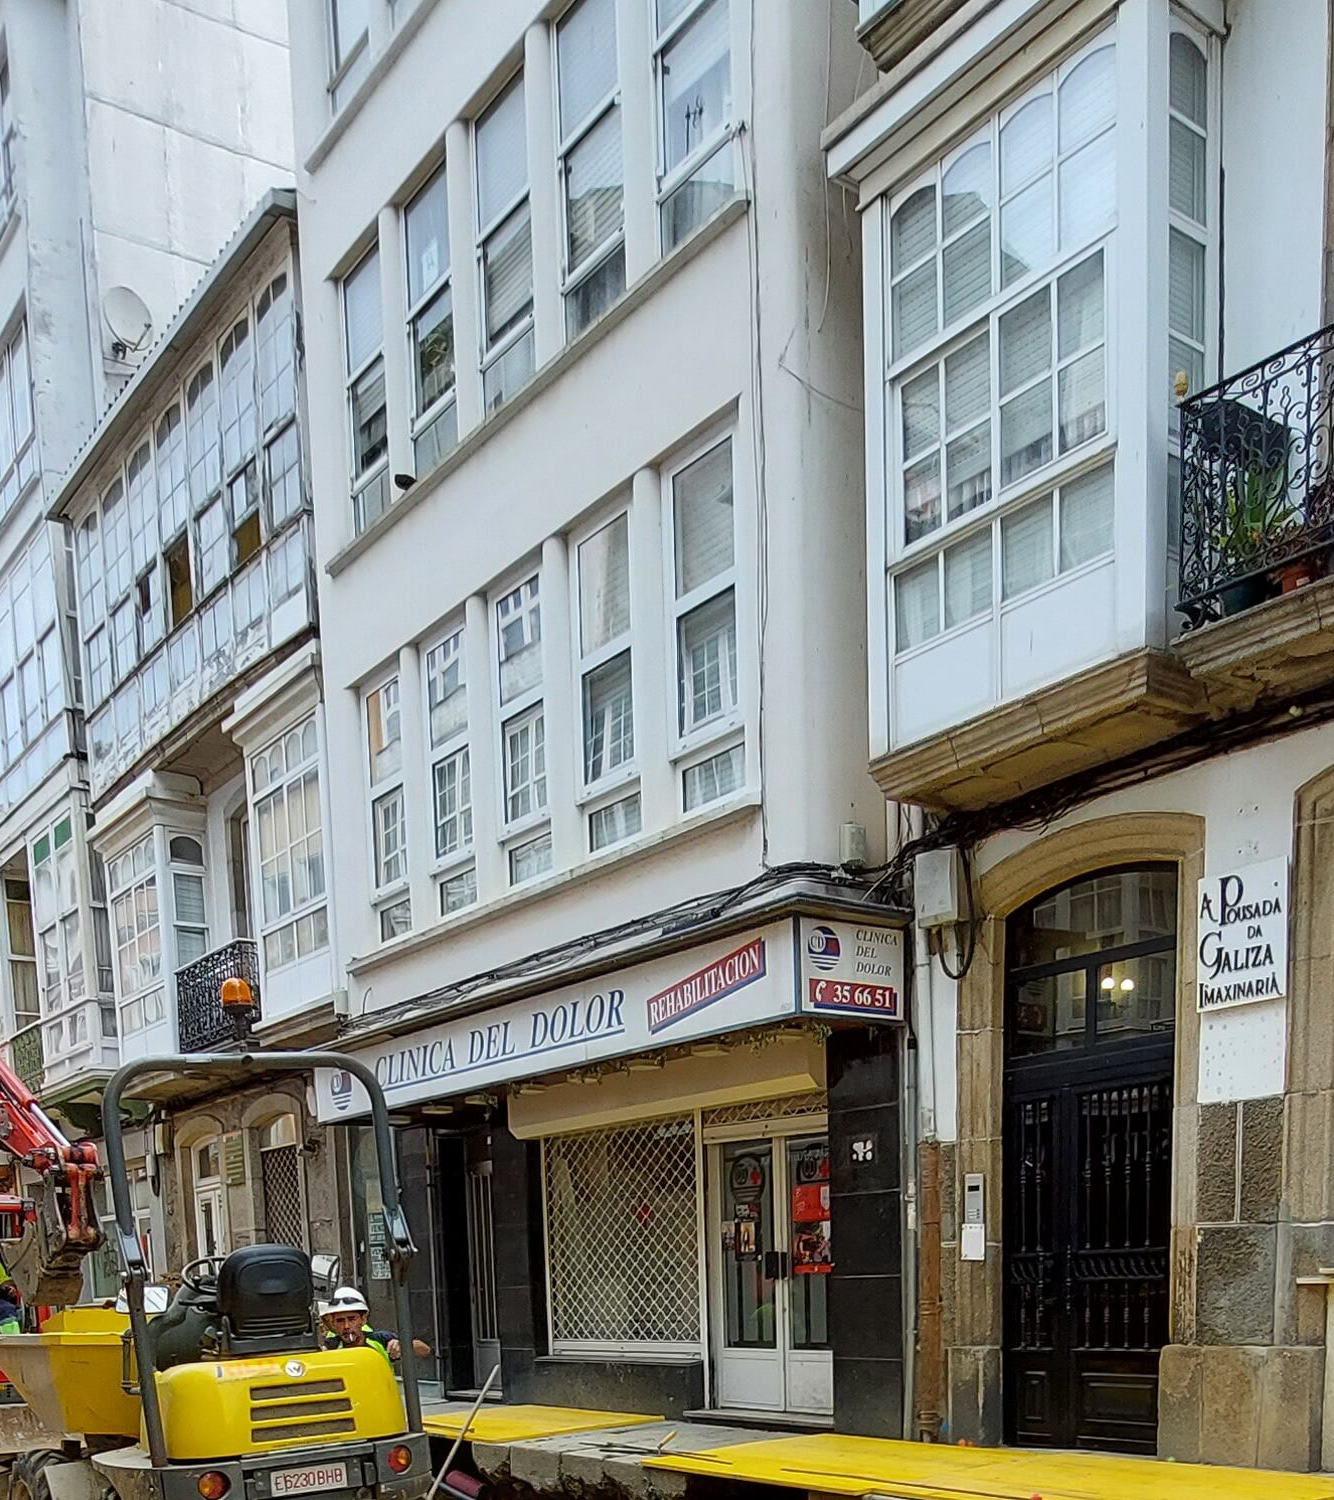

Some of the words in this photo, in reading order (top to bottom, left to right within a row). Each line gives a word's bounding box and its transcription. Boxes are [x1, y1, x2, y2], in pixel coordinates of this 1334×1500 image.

[1199, 892, 1218, 922] A
[855, 929, 898, 946] CLINICA
[1247, 925, 1263, 940] DA
[855, 946, 878, 958] DEL
[1199, 930, 1274, 980] GALIZA
[856, 962, 892, 976] DOLOR
[650, 944, 760, 1026] REHABILITACION
[833, 985, 851, 1003] 35
[854, 987, 871, 1005] 66
[875, 989, 891, 1007] 51
[1198, 971, 1283, 1009] IMAXINARIA
[375, 1037, 455, 1087] CLINICA
[468, 1020, 514, 1064] DEL
[530, 989, 625, 1048] DOLOR
